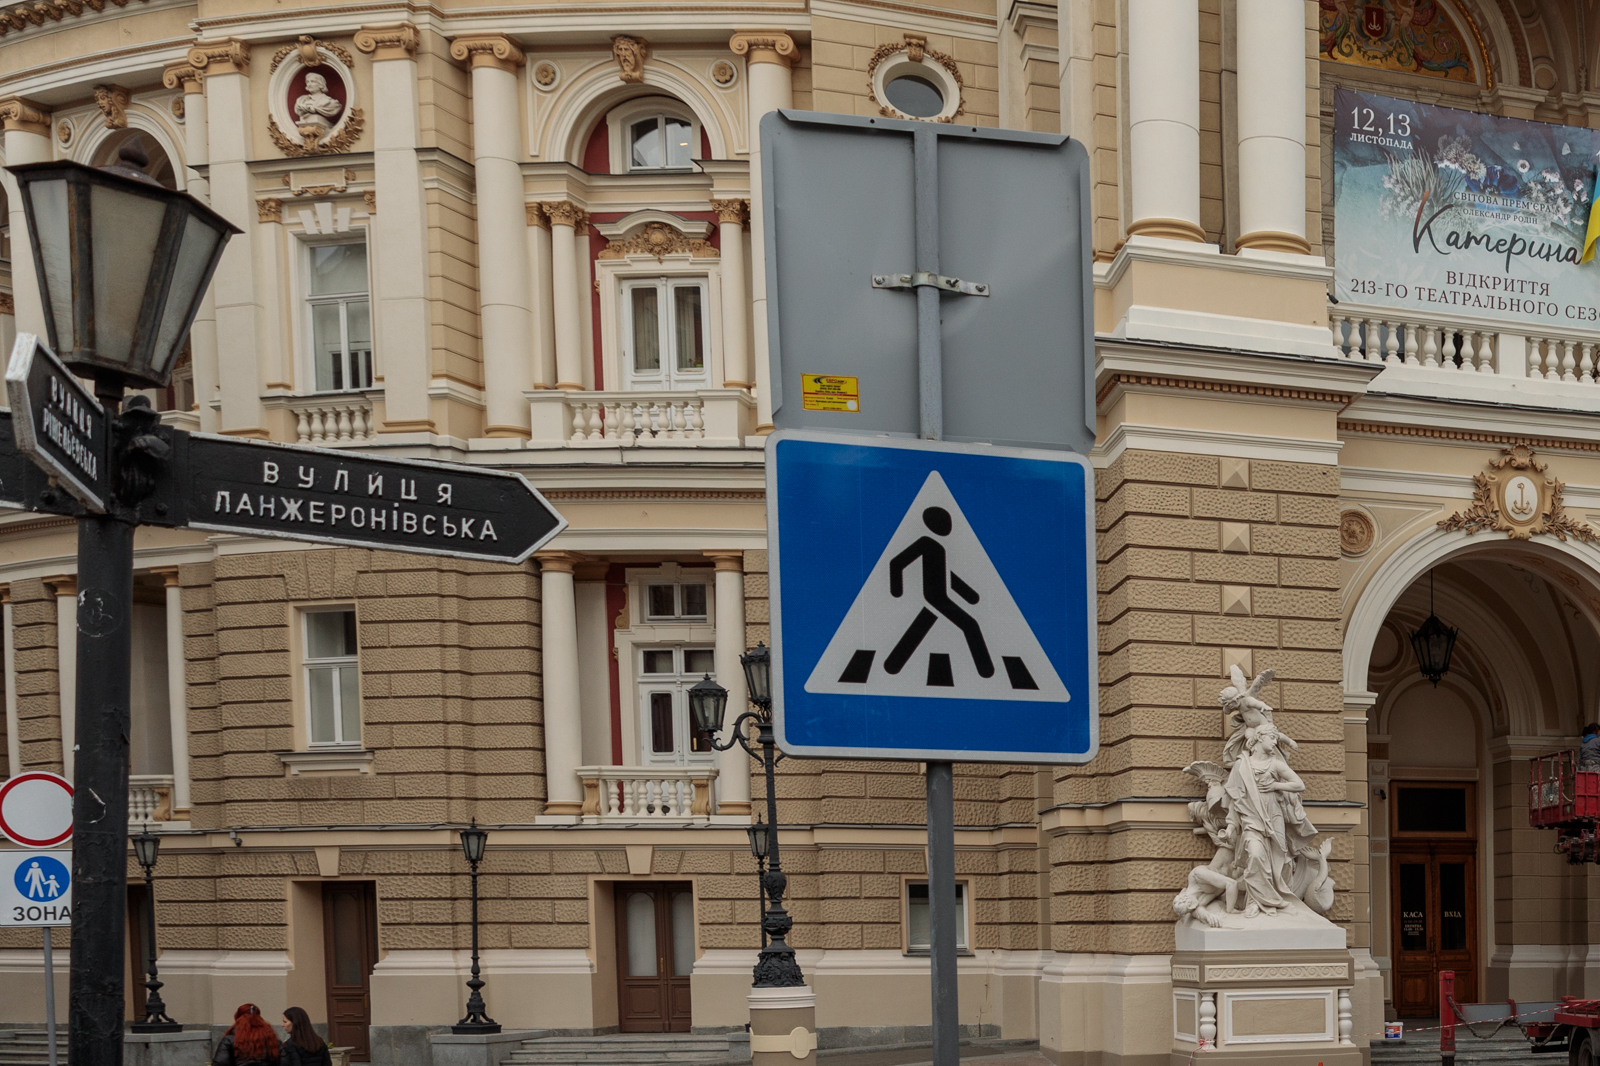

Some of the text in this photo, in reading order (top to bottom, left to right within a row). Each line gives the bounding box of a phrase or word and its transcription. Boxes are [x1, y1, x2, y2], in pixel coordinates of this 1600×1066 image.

[1349, 132, 1414, 150] ЛИСТОПАДА
[1453, 191, 1499, 206] СВІТОВА
[1462, 208, 1538, 225] ОЛЕКСАНДР РОДІН
[1412, 190, 1583, 274] Катерина
[1445, 270, 1550, 297] ВІДКРИТТЯ
[1351, 278, 1408, 299] 213-ГО
[1414, 286, 1559, 317] ТЕАТРАЛЬНОГО
[51, 375, 92, 440] ВУЛИЦЯ
[262, 461, 453, 506] ВУЛИЦЯ
[12, 905, 72, 922] ЗОНА
